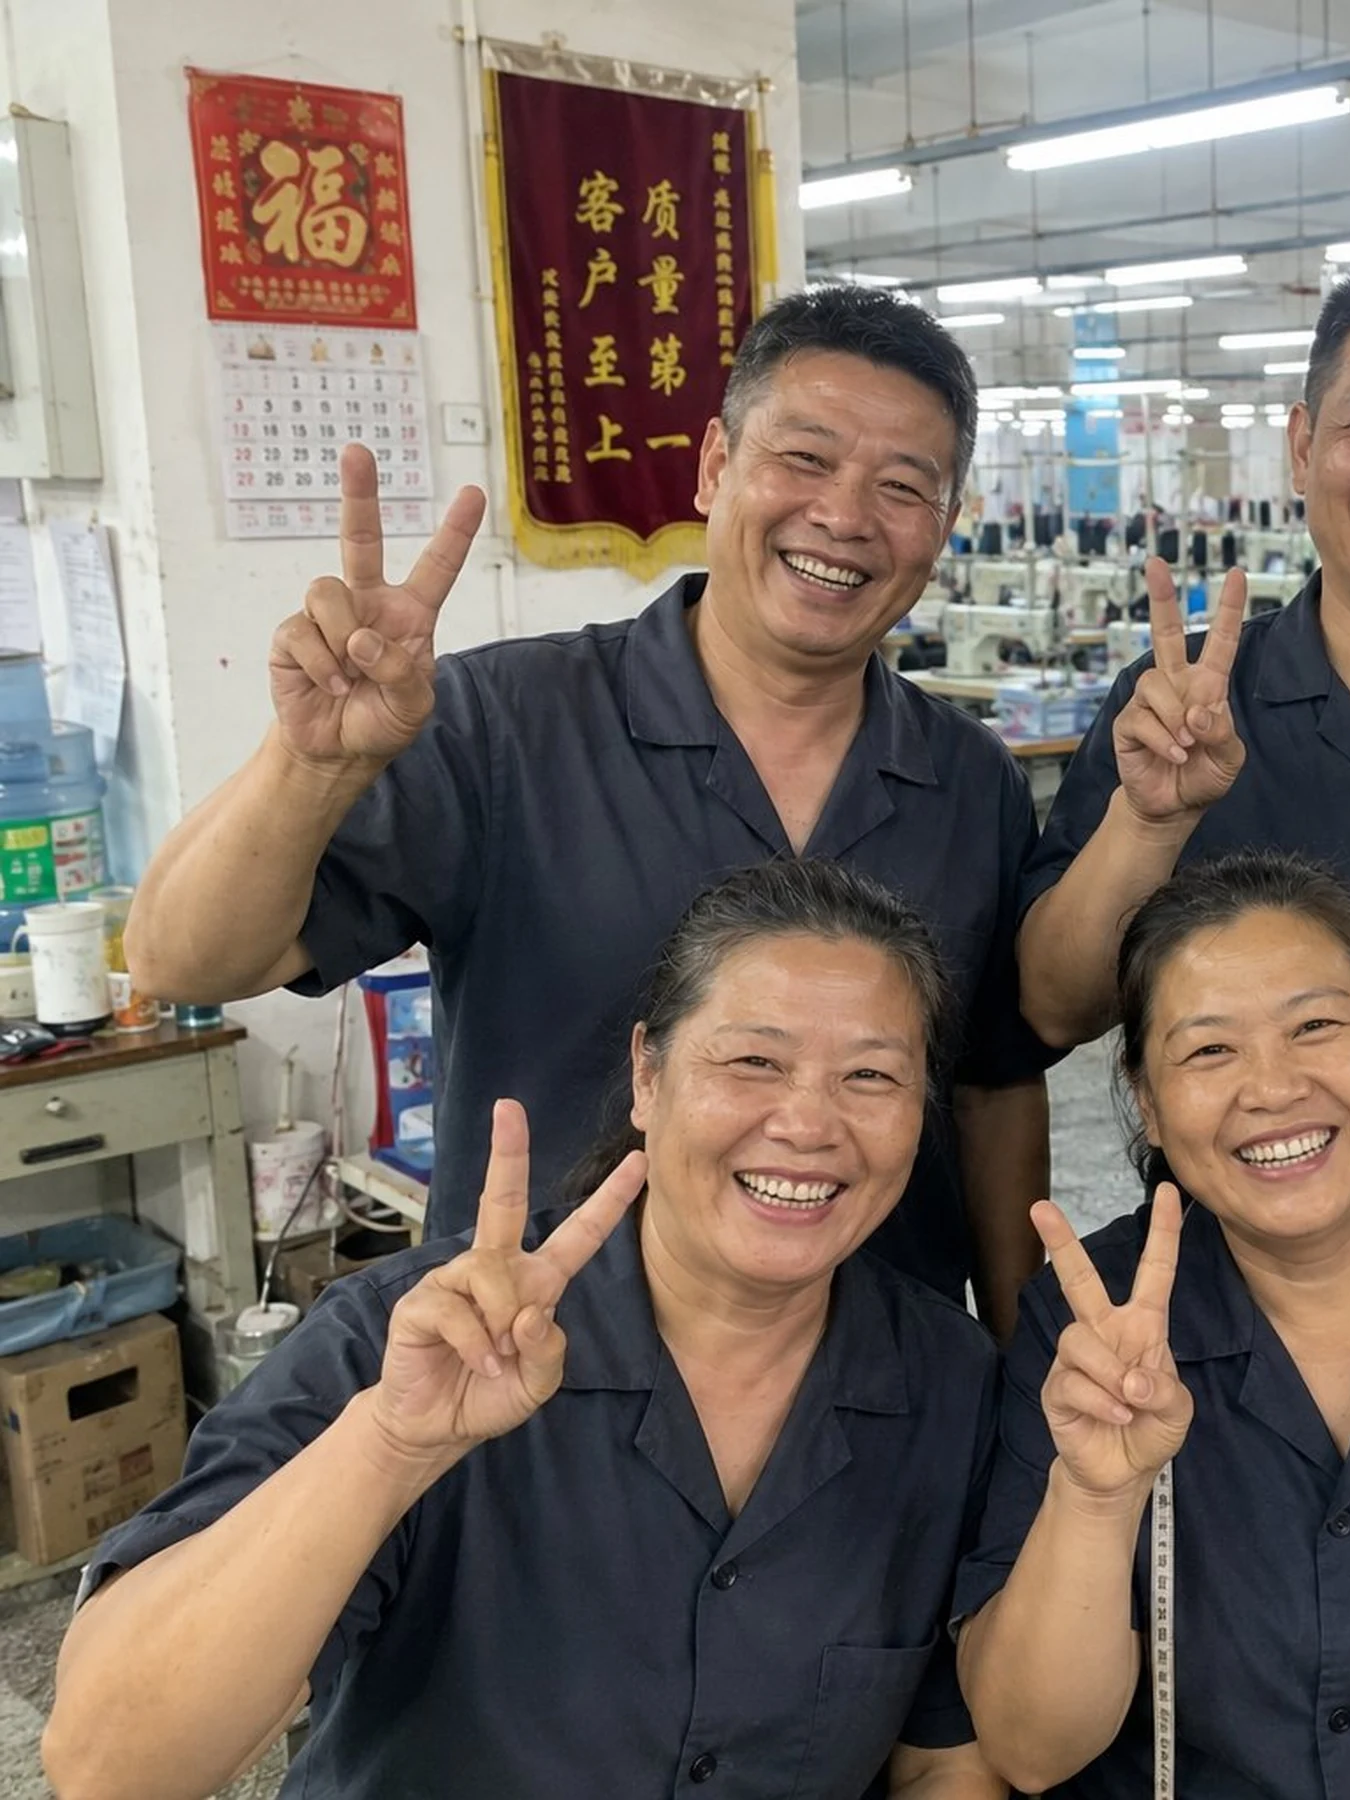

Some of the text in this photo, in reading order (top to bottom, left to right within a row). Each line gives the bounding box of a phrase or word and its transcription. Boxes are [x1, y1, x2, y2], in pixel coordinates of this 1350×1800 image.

[251, 139, 368, 268] 福
[574, 169, 633, 463] 客户至上
[637, 179, 692, 450] 质量第一
